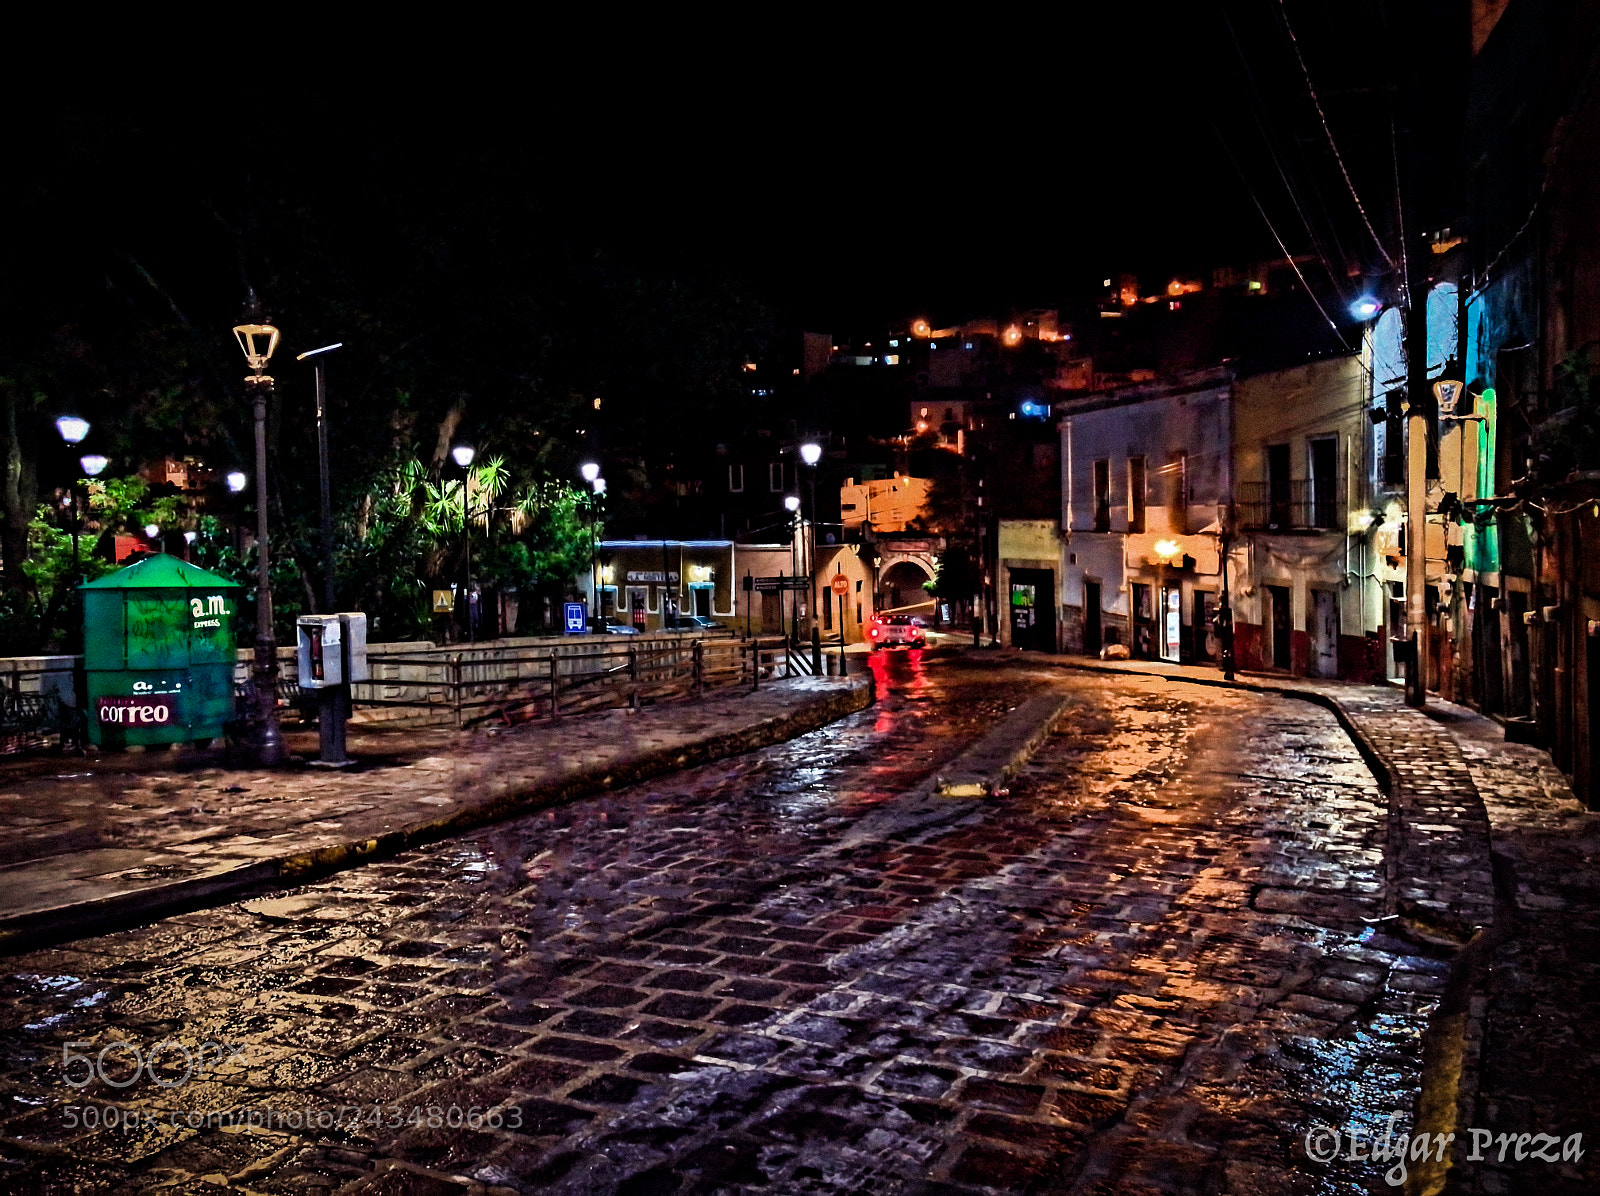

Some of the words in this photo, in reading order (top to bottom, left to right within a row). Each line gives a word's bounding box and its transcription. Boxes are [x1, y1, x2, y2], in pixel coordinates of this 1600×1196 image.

[834, 580, 848, 589] ALTO
[190, 595, 230, 618] a.m.
[100, 704, 169, 723] correo
